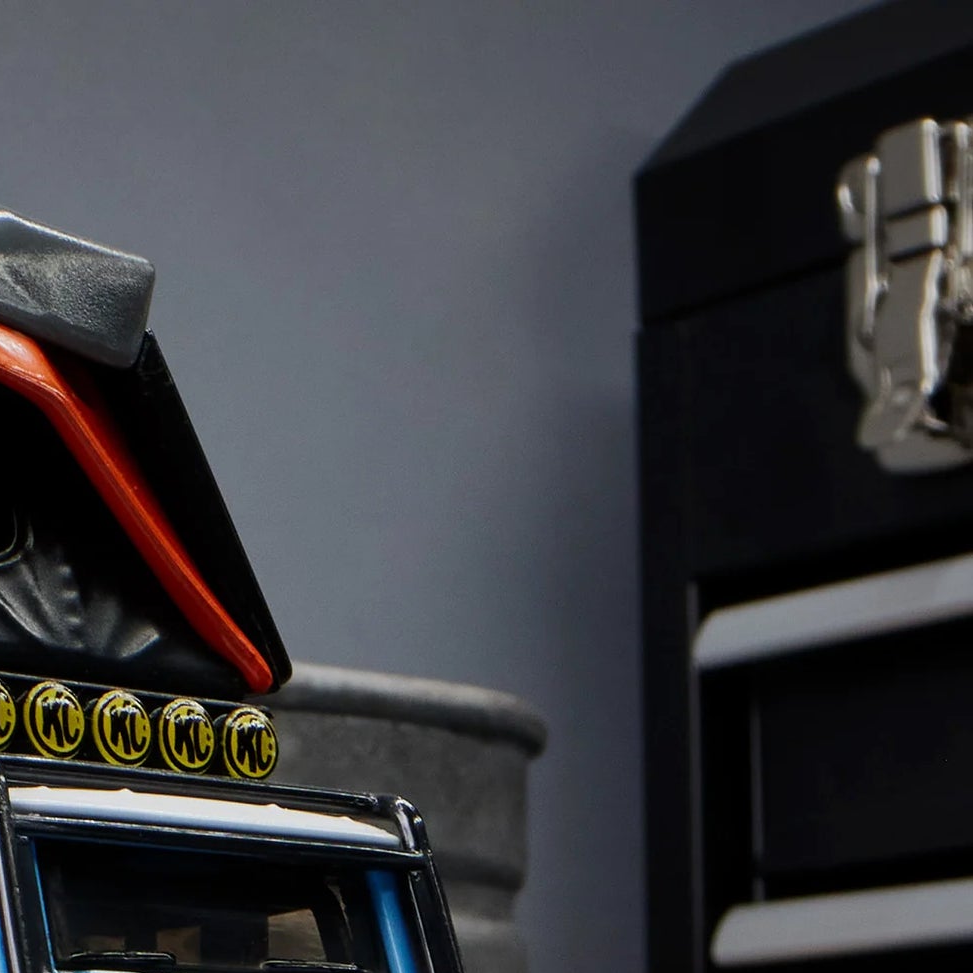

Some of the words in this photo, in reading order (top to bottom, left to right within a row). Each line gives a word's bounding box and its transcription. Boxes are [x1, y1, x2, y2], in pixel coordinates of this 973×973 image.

[40, 692, 80, 748] KC
[109, 702, 147, 755] KC
[172, 712, 210, 764] KC
[236, 722, 275, 773] KC
